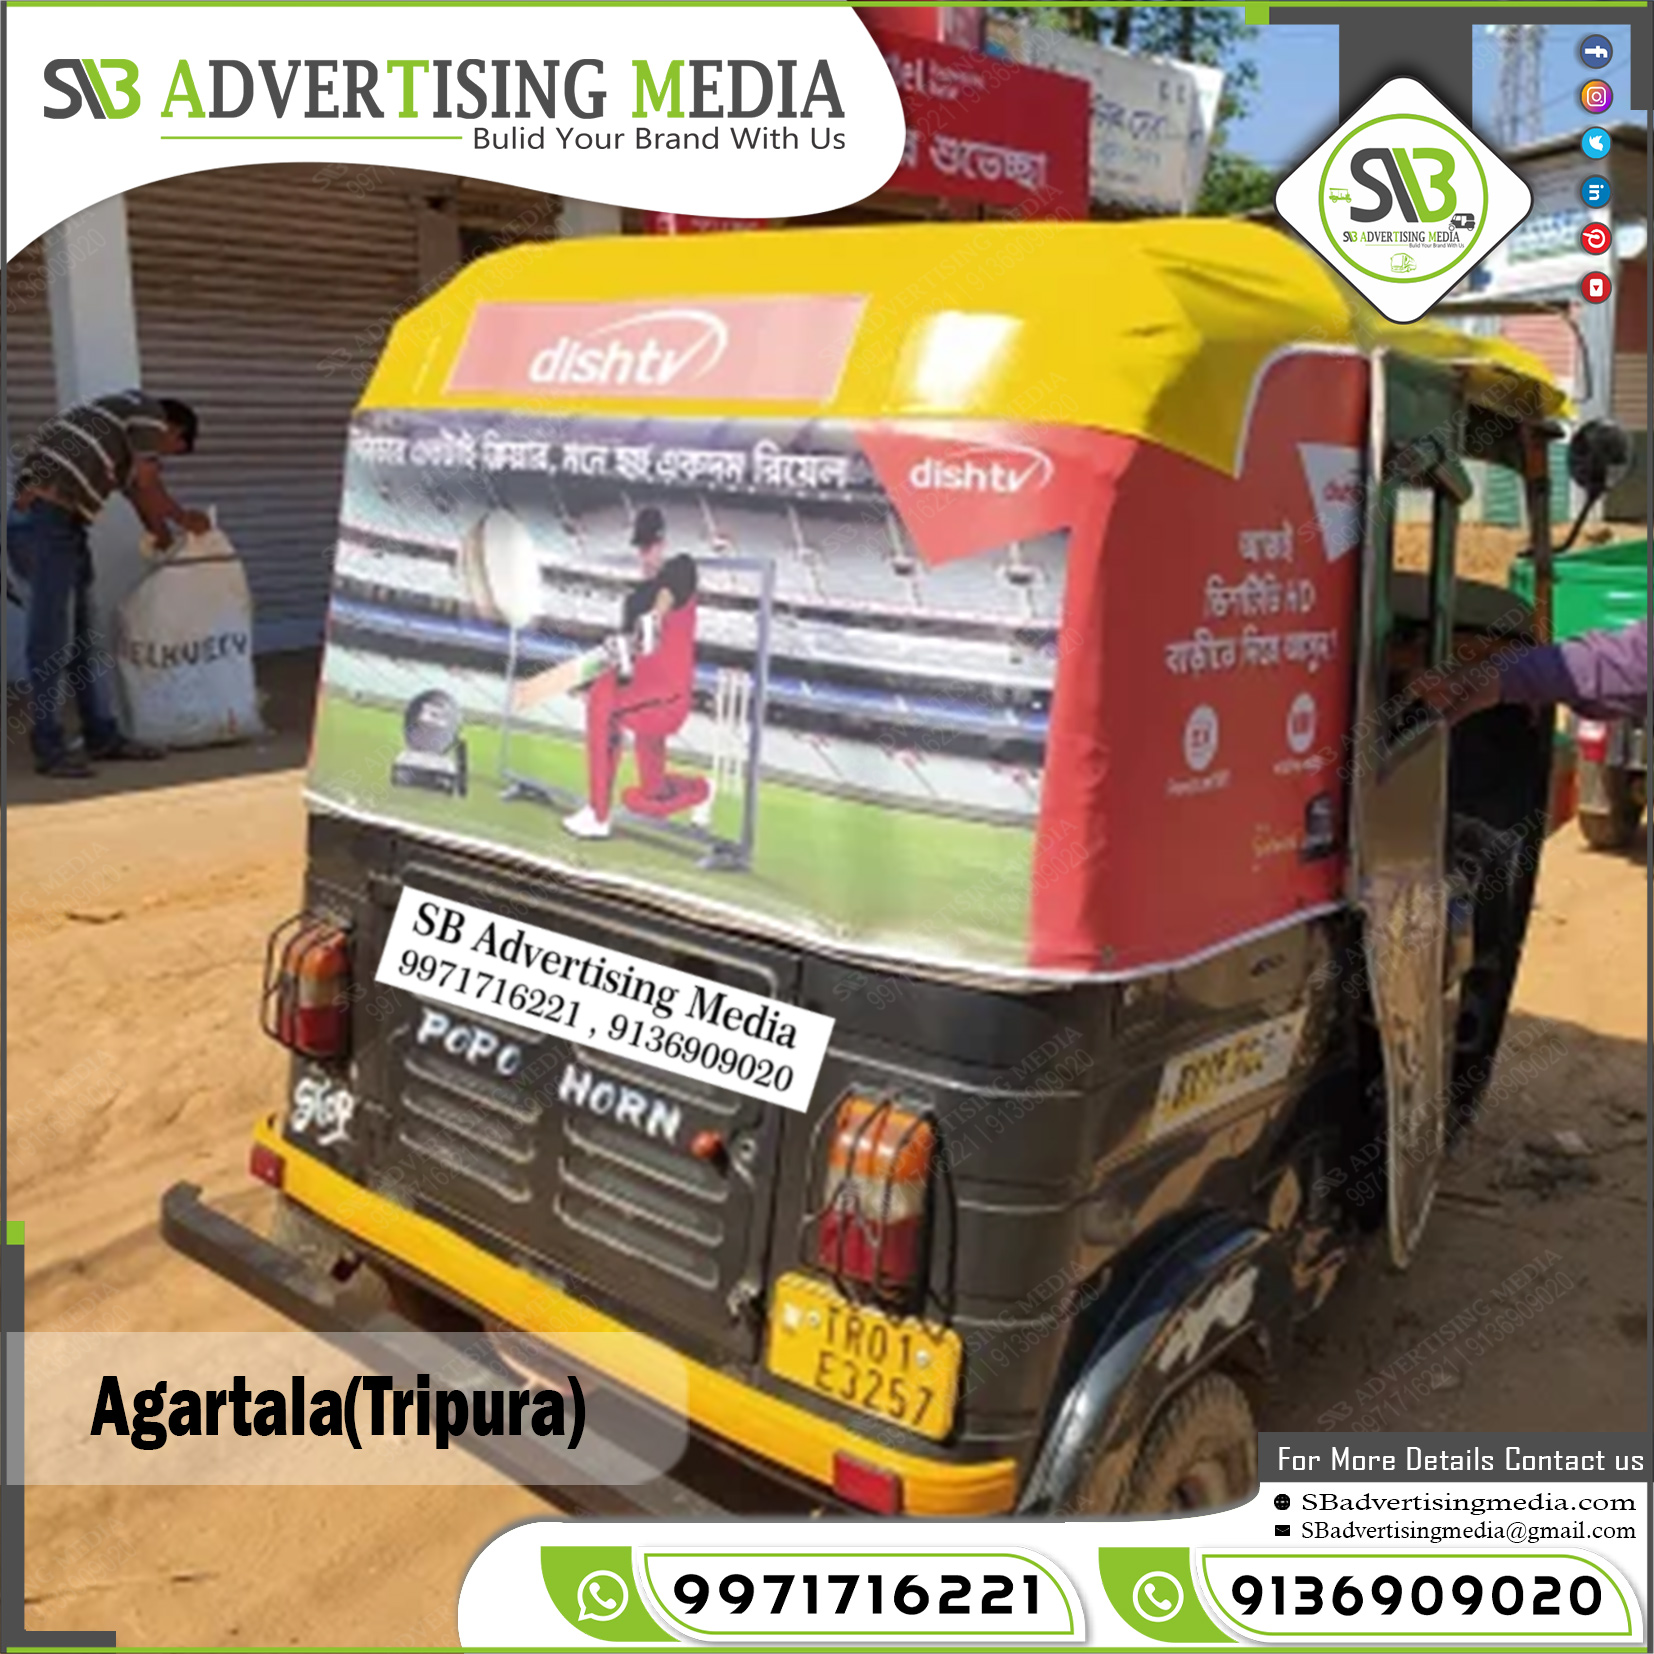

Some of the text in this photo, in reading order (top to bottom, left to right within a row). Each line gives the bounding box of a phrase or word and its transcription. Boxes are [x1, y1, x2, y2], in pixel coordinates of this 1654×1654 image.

[558, 1063, 682, 1145] HORN
[828, 1306, 911, 1370] TR01
[815, 1350, 933, 1426] E3257
